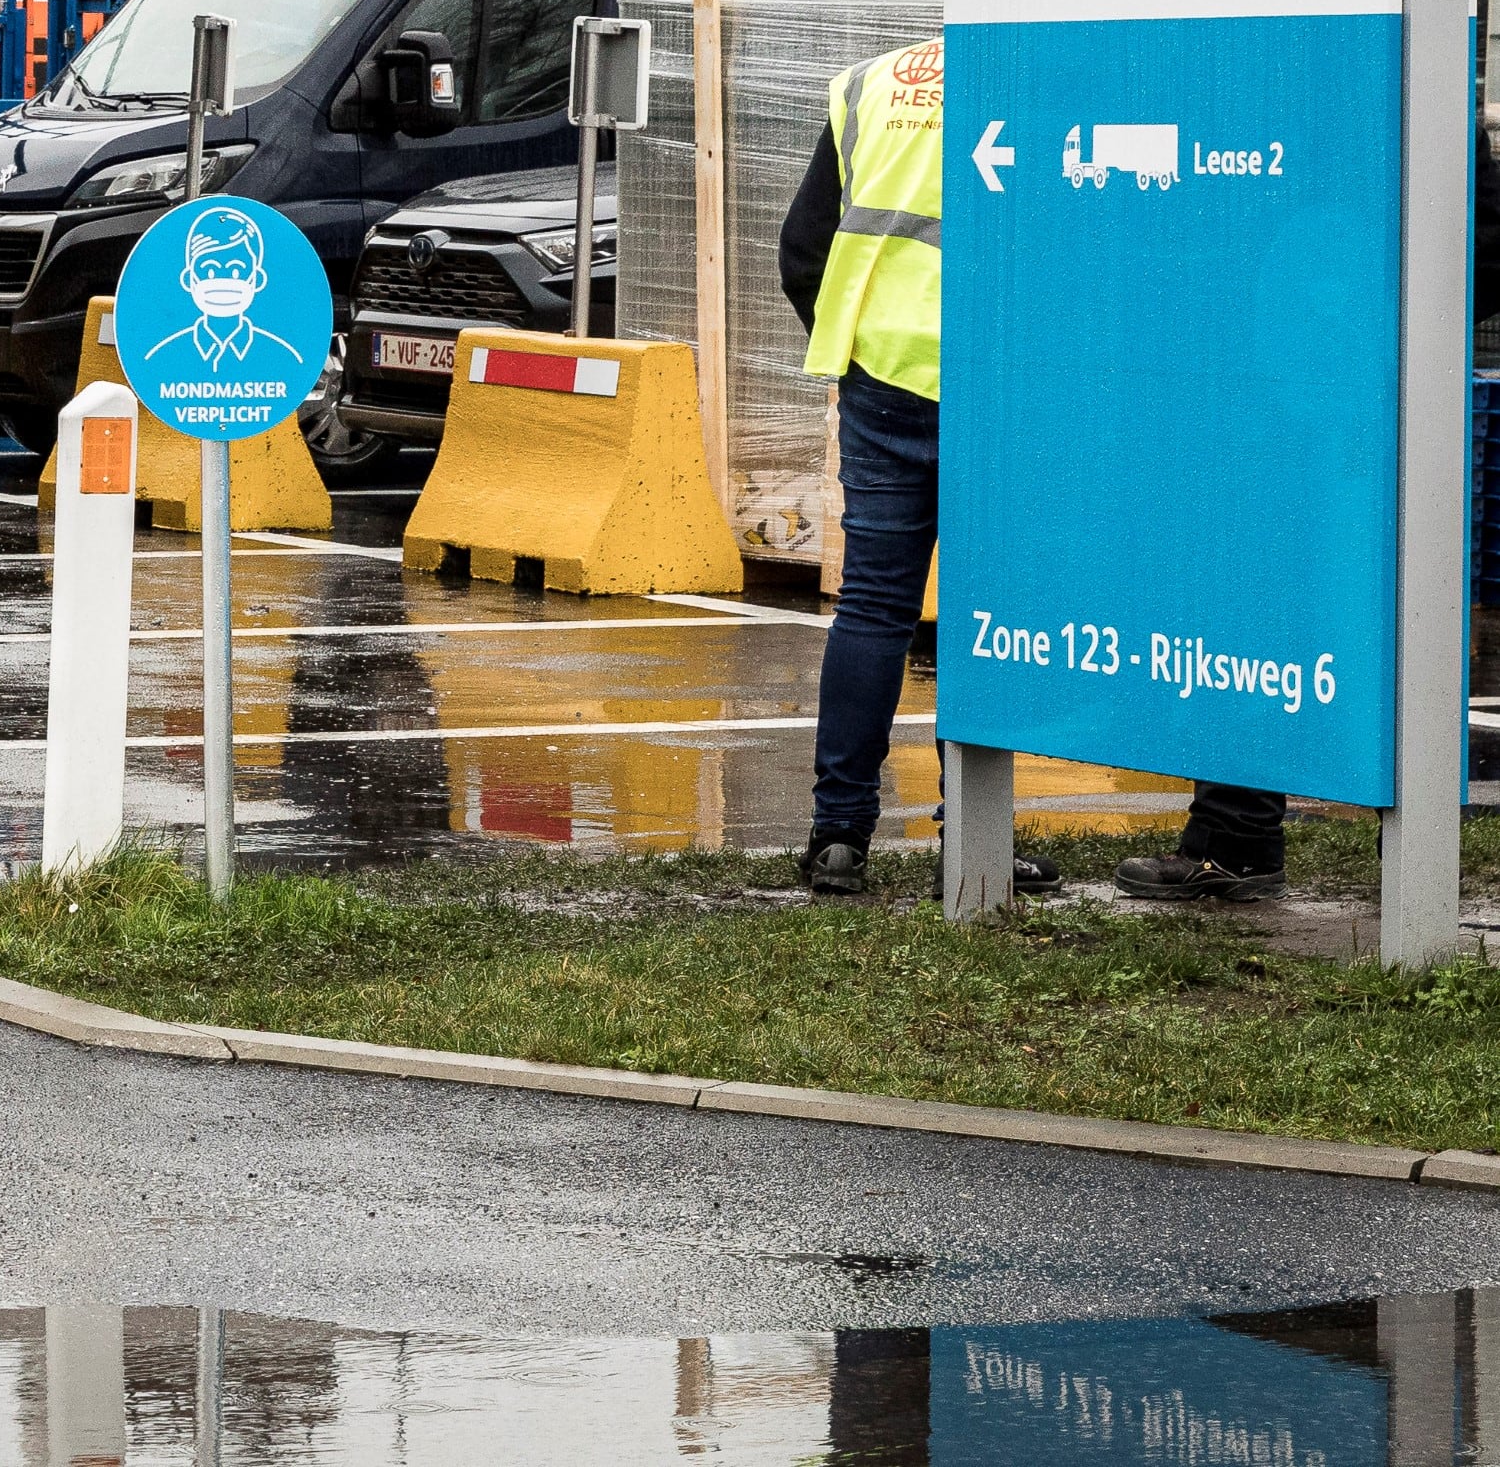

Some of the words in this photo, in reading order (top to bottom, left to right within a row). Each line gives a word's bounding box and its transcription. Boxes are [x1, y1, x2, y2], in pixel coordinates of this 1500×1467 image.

[891, 88, 944, 108] H.ES
[1194, 141, 1262, 176] Lease
[1268, 141, 1284, 176] 2
[382, 339, 455, 369] 1-VUF-245
[159, 382, 288, 399] MONDMASKER
[174, 405, 273, 423] VERPLICHT
[972, 610, 1051, 666] Zone
[1060, 622, 1121, 676] 123
[1151, 632, 1302, 714] Rijksweg
[1313, 652, 1337, 705] 6
